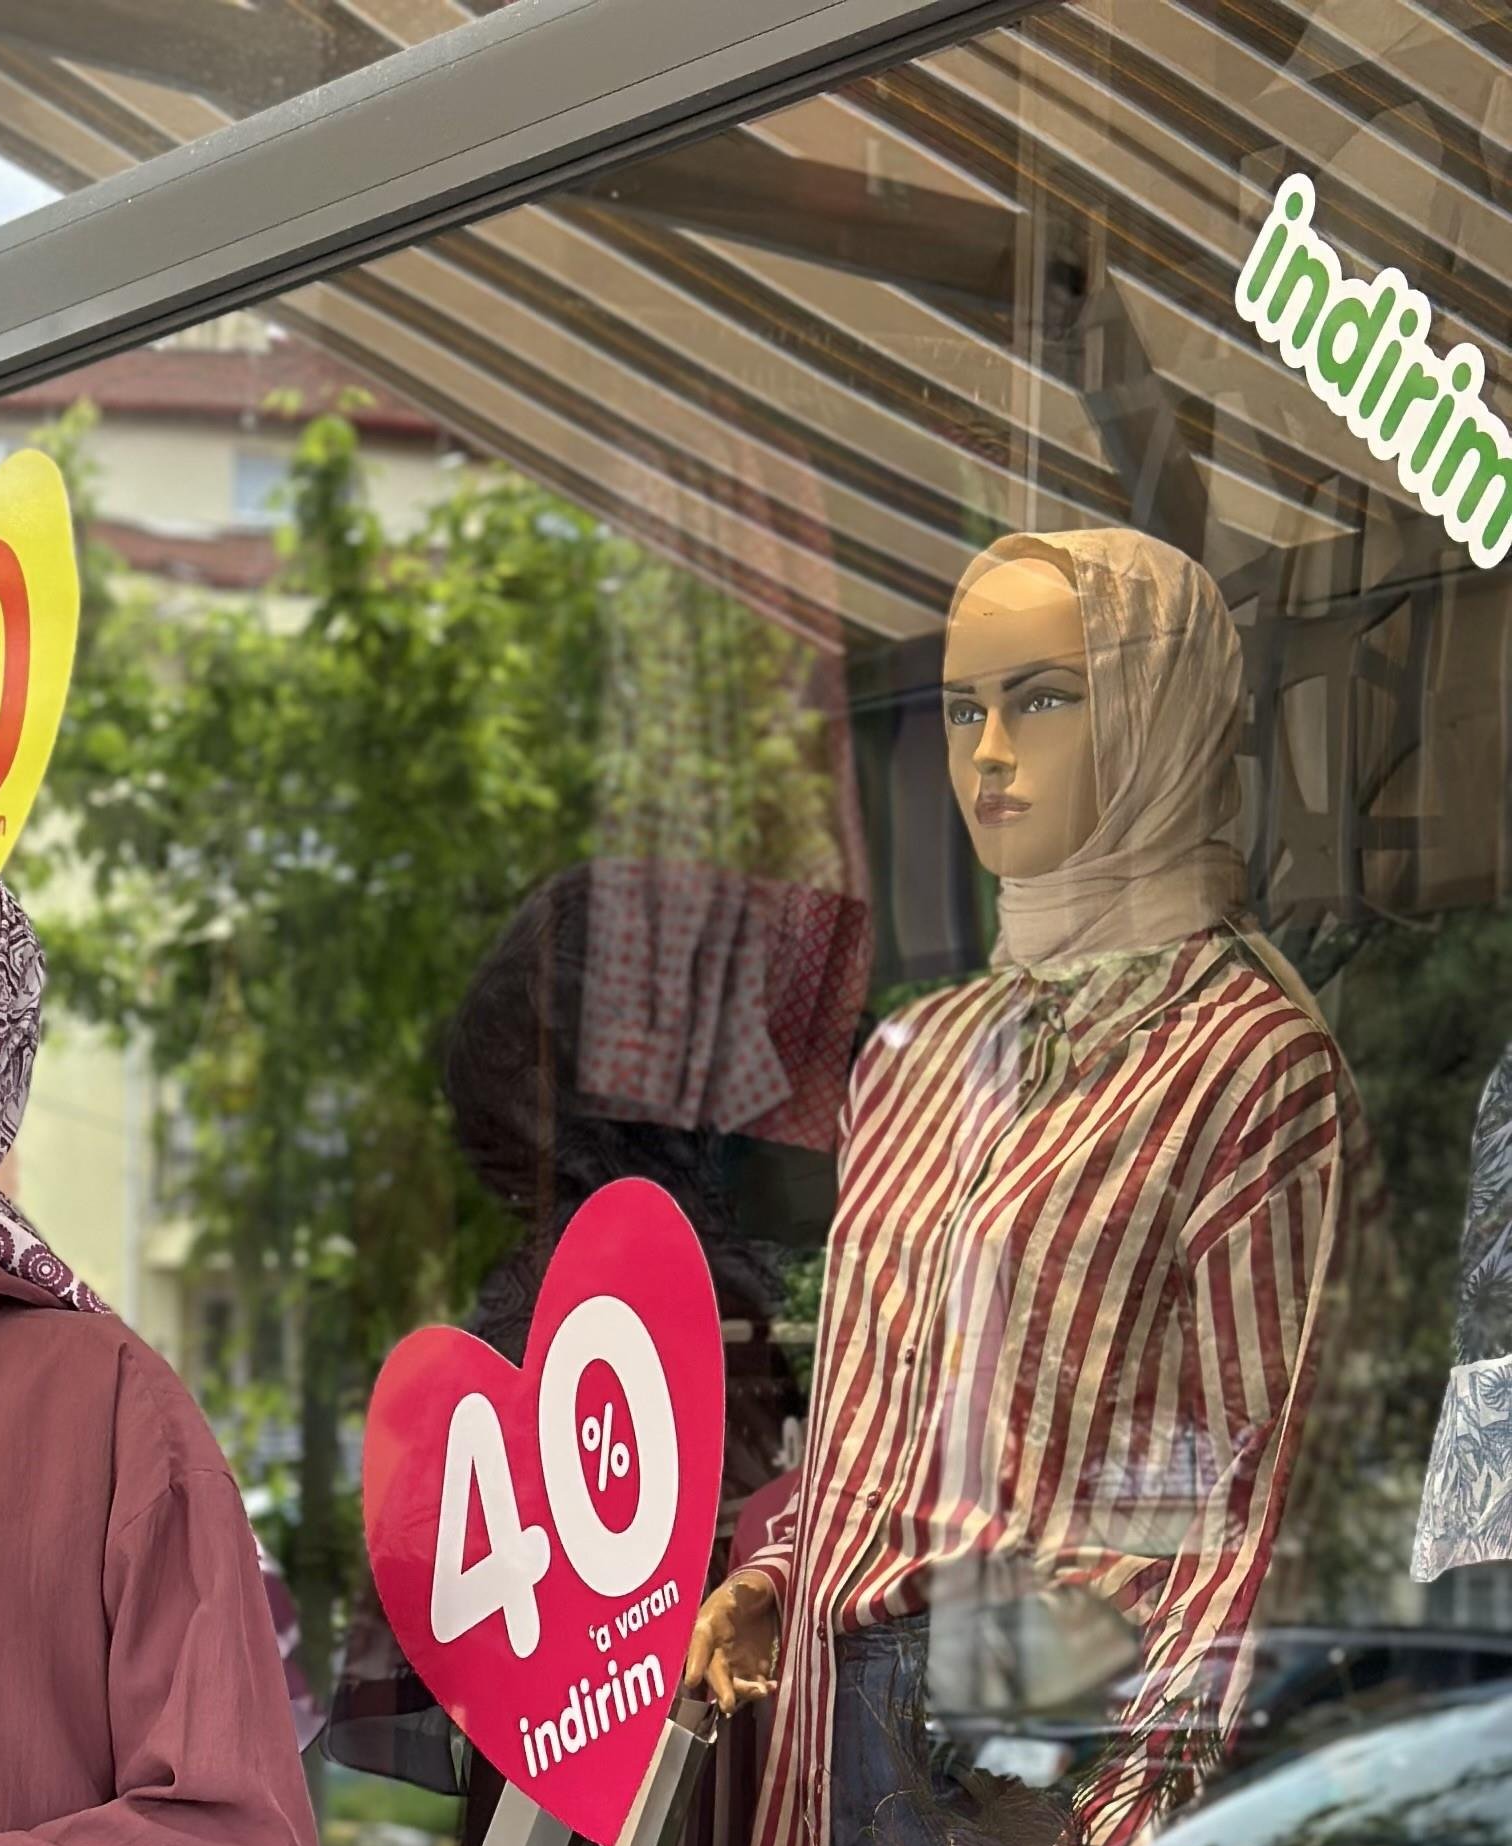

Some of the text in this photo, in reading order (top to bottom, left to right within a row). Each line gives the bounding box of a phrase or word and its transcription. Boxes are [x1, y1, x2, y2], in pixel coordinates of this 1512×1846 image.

[1246, 191, 1512, 550] indirim
[430, 1295, 679, 1658] 40
[519, 1654, 665, 1778] indirim
[615, 1579, 680, 1640] varan
